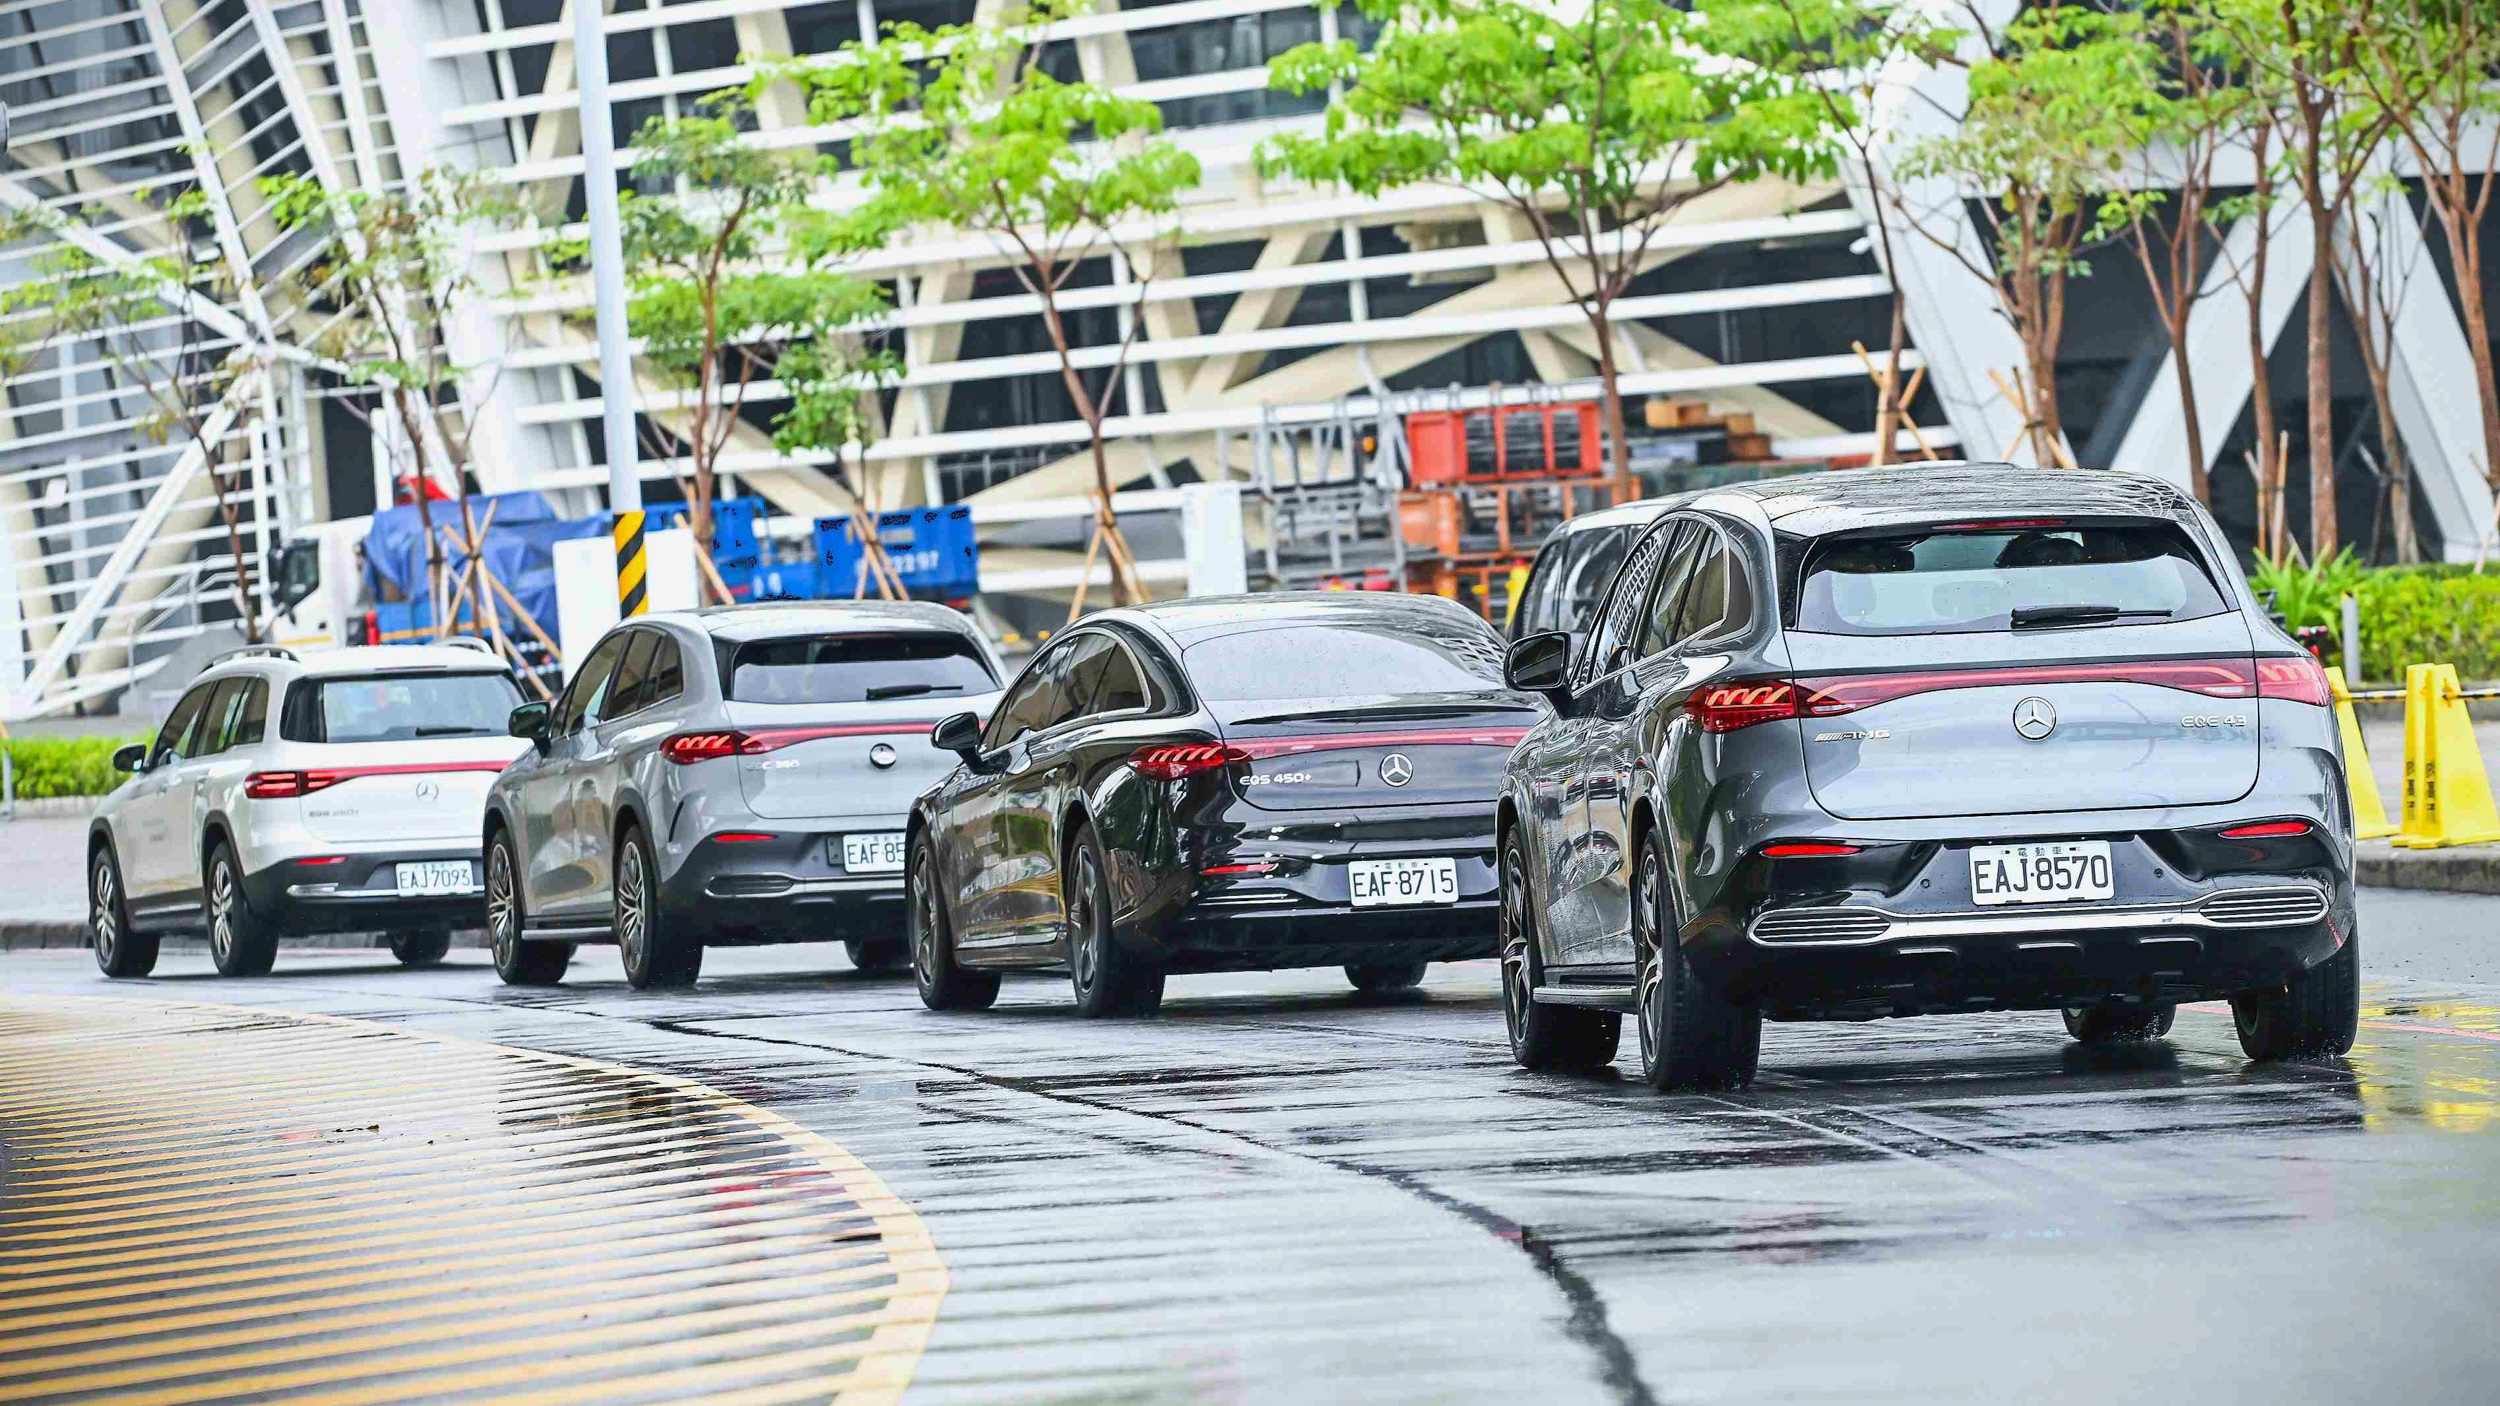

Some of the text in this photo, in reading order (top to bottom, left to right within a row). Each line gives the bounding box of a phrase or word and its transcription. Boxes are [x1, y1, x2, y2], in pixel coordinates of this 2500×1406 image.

[2181, 714, 2247, 728] EQE 43
[1836, 729, 1891, 740] AMG
[1239, 772, 1312, 786] EQS 450+
